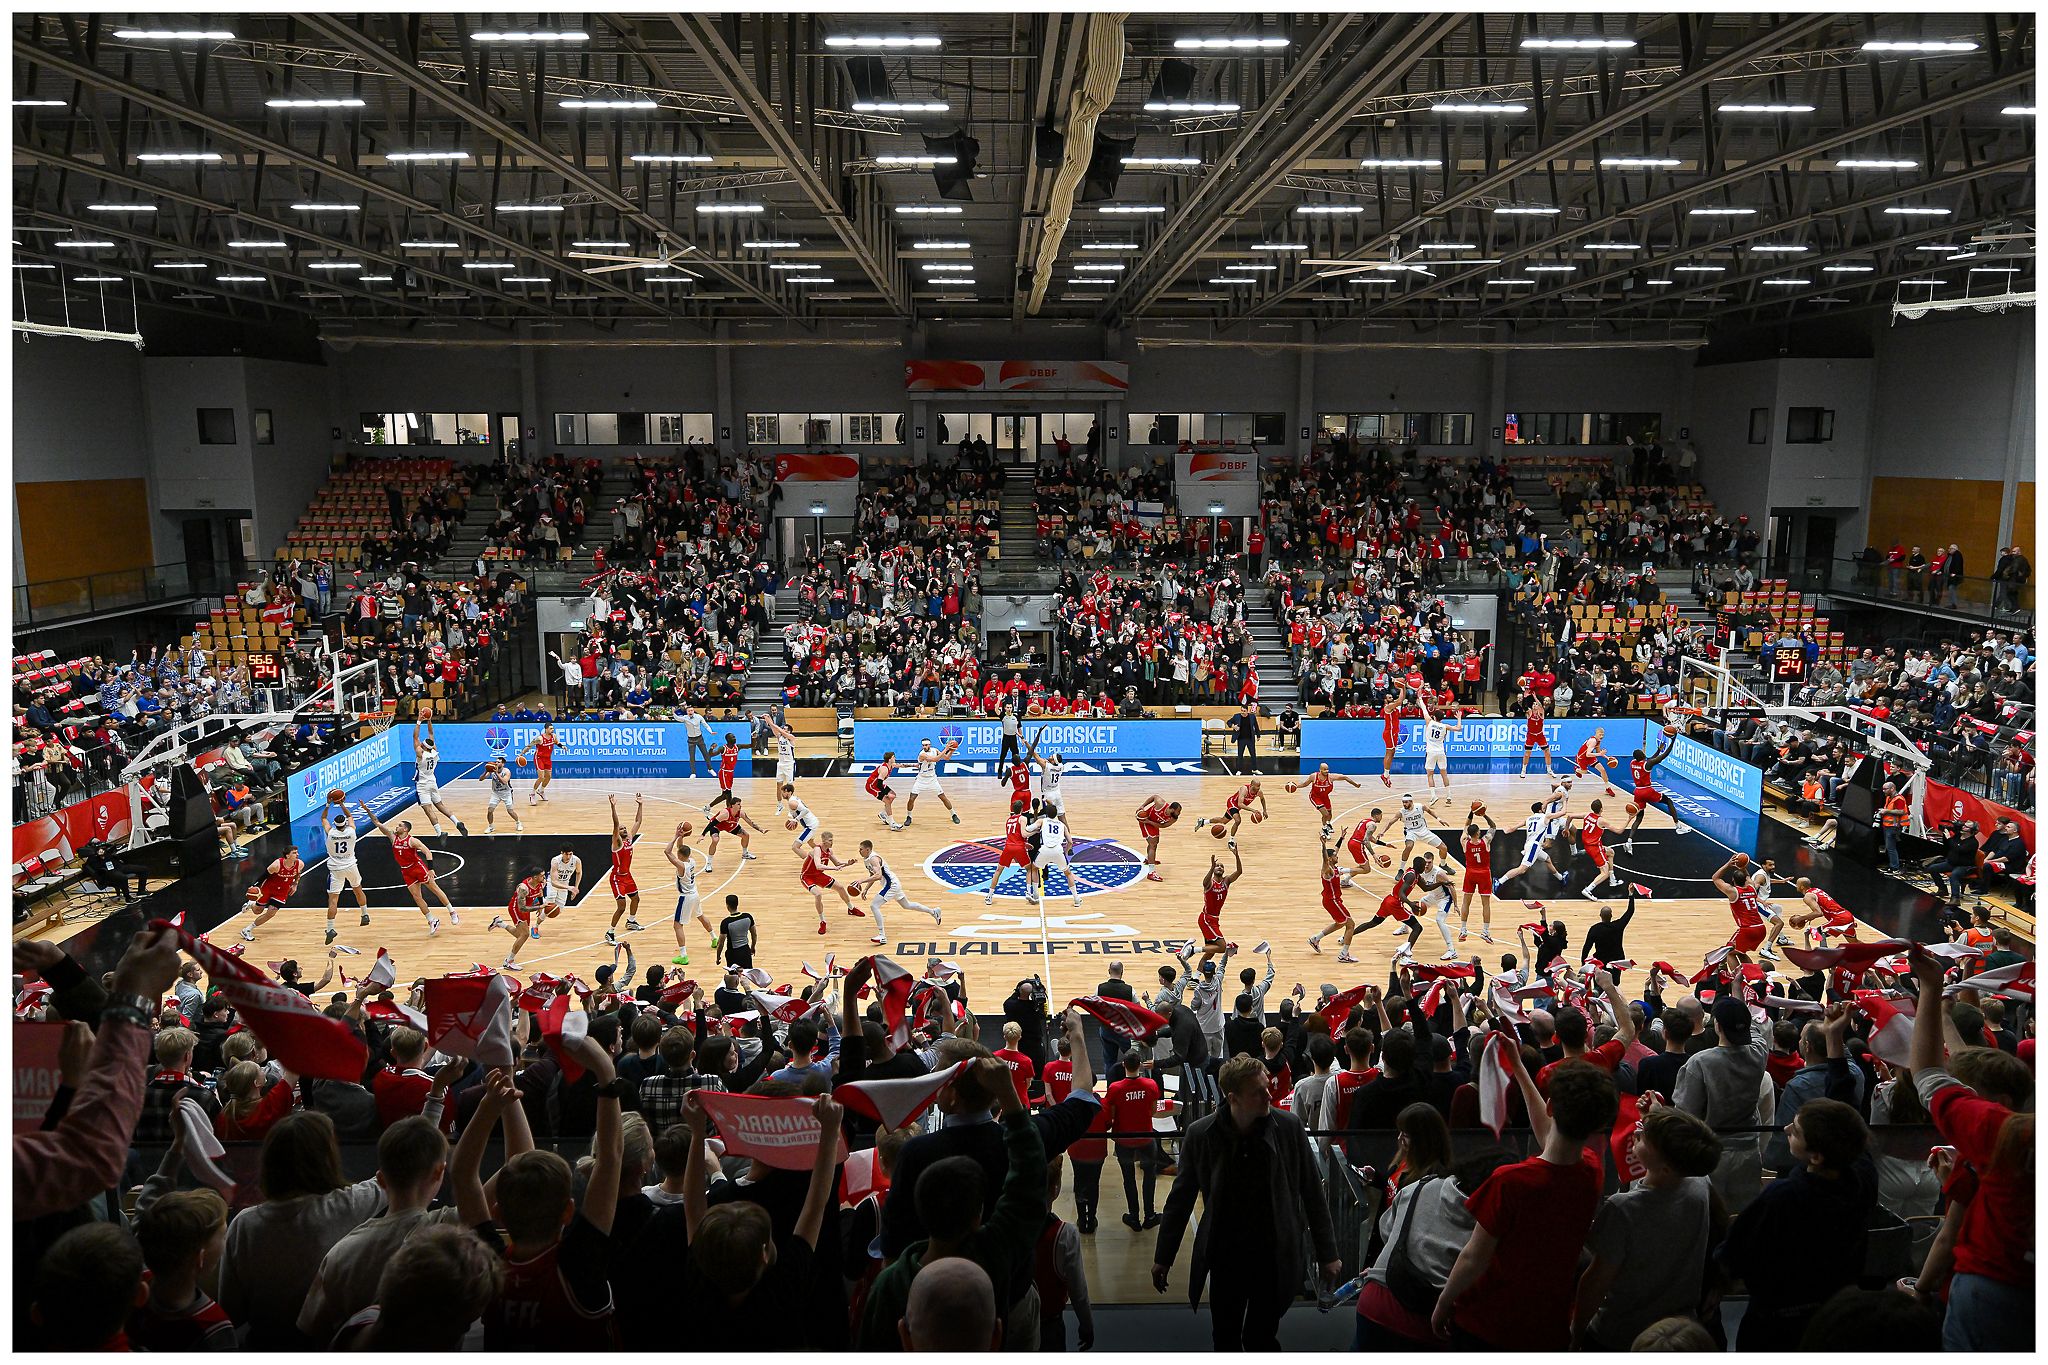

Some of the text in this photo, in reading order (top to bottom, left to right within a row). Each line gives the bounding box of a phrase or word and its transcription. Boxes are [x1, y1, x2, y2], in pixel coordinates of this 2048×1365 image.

[1030, 369, 1058, 377] DBBF
[1220, 461, 1247, 470] DBBF
[1717, 624, 1729, 639] 24
[248, 654, 273, 665] 56.6
[1776, 649, 1800, 660] 56.6
[254, 665, 277, 678] 24
[1779, 660, 1802, 674] 24
[556, 728, 666, 747] EUROBASKET
[1432, 729, 1440, 739] 18
[1453, 724, 1562, 743] EUROBASET
[598, 748, 628, 756] POLAND
[637, 748, 667, 756] LATVIA
[968, 747, 999, 755] CYPRUS
[1049, 747, 1079, 755] POLAND
[1088, 747, 1118, 755] LATVIA
[1451, 744, 1485, 752] FINLAND
[1492, 744, 1523, 752] POLAND
[319, 736, 390, 788] FIBA EUROBASKET
[1687, 744, 1746, 787] EUROBASKET
[1019, 774, 1026, 783] 0
[1051, 773, 1060, 784] 13
[1048, 823, 1059, 835] 18
[1528, 821, 1537, 832] 21
[1584, 820, 1595, 834] 77
[334, 841, 347, 854] 13
[896, 941, 1192, 956] QUALIFIERS
[1055, 1071, 1073, 1082] STAFF
[1125, 1090, 1146, 1102] STAFF
